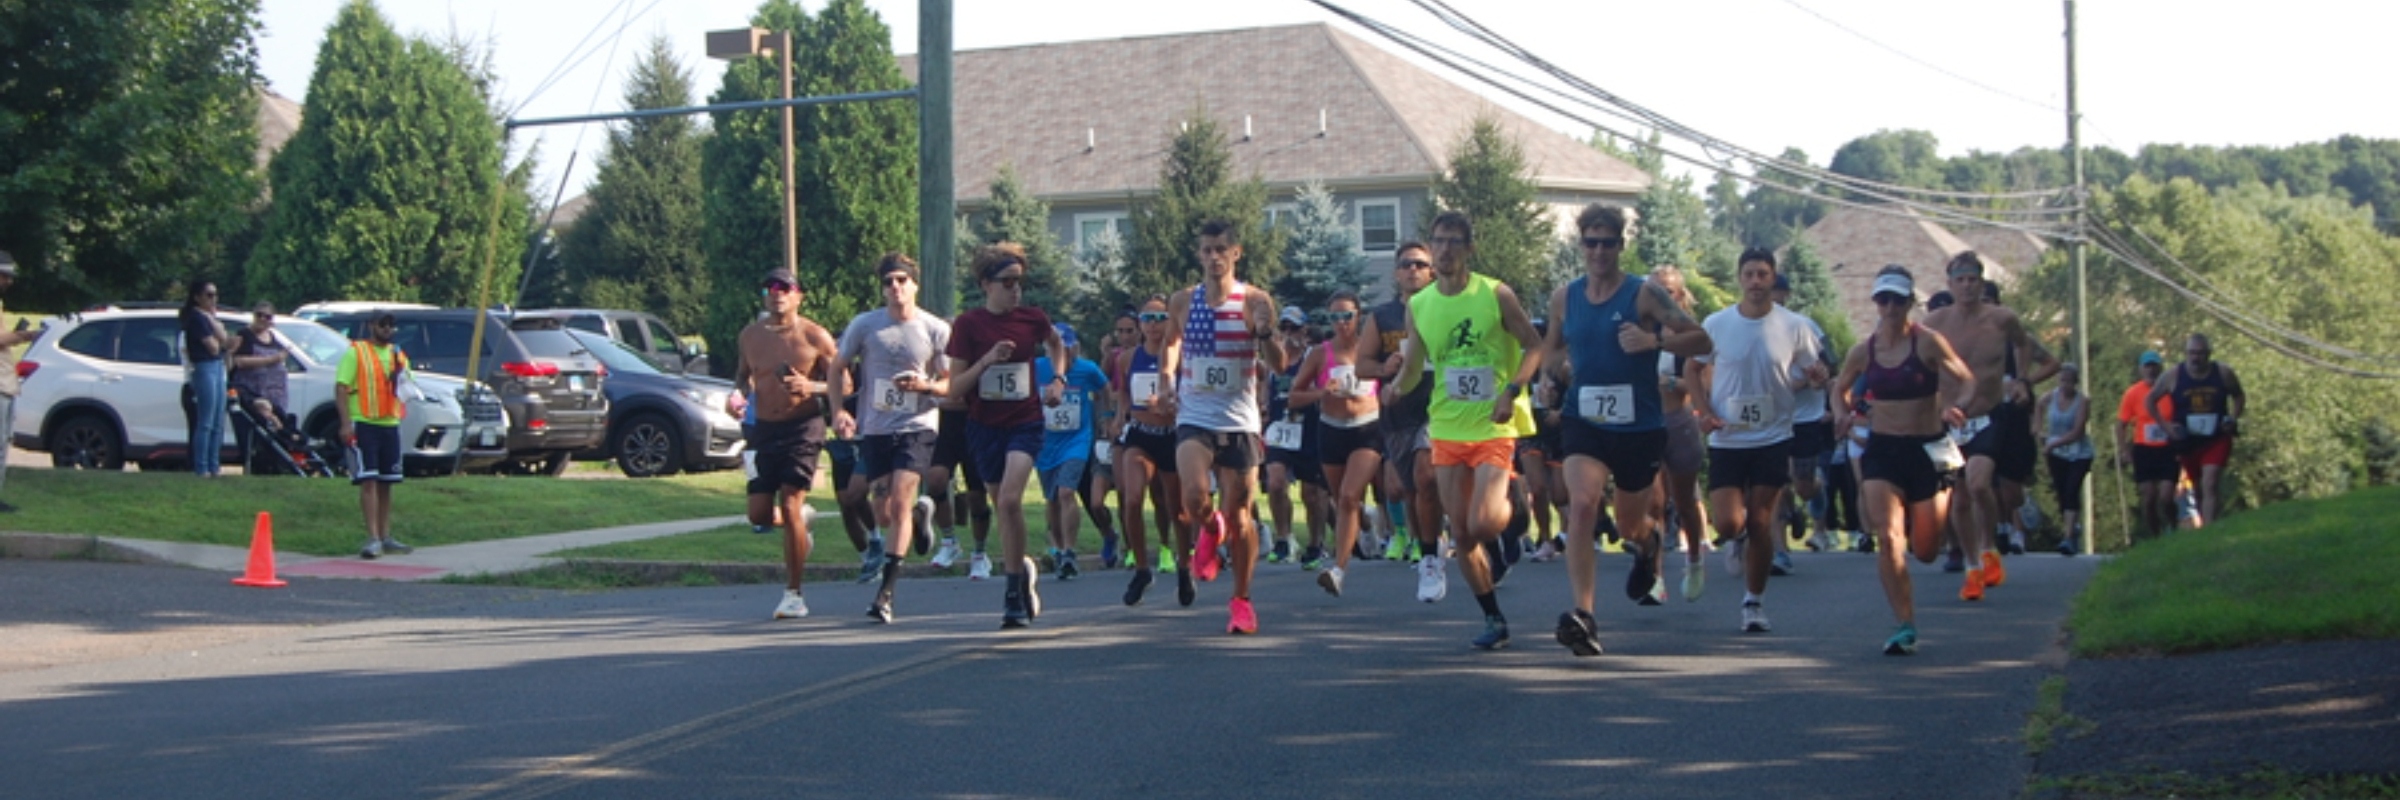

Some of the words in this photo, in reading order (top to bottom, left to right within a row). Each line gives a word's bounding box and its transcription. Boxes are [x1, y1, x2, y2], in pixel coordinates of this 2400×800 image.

[997, 373, 1016, 393] 15
[1206, 367, 1227, 385] 60
[1458, 375, 1480, 396] 52
[885, 389, 905, 406] 63
[1595, 394, 1617, 416] 72
[1054, 410, 1070, 425] 55
[1740, 404, 1761, 423] 45
